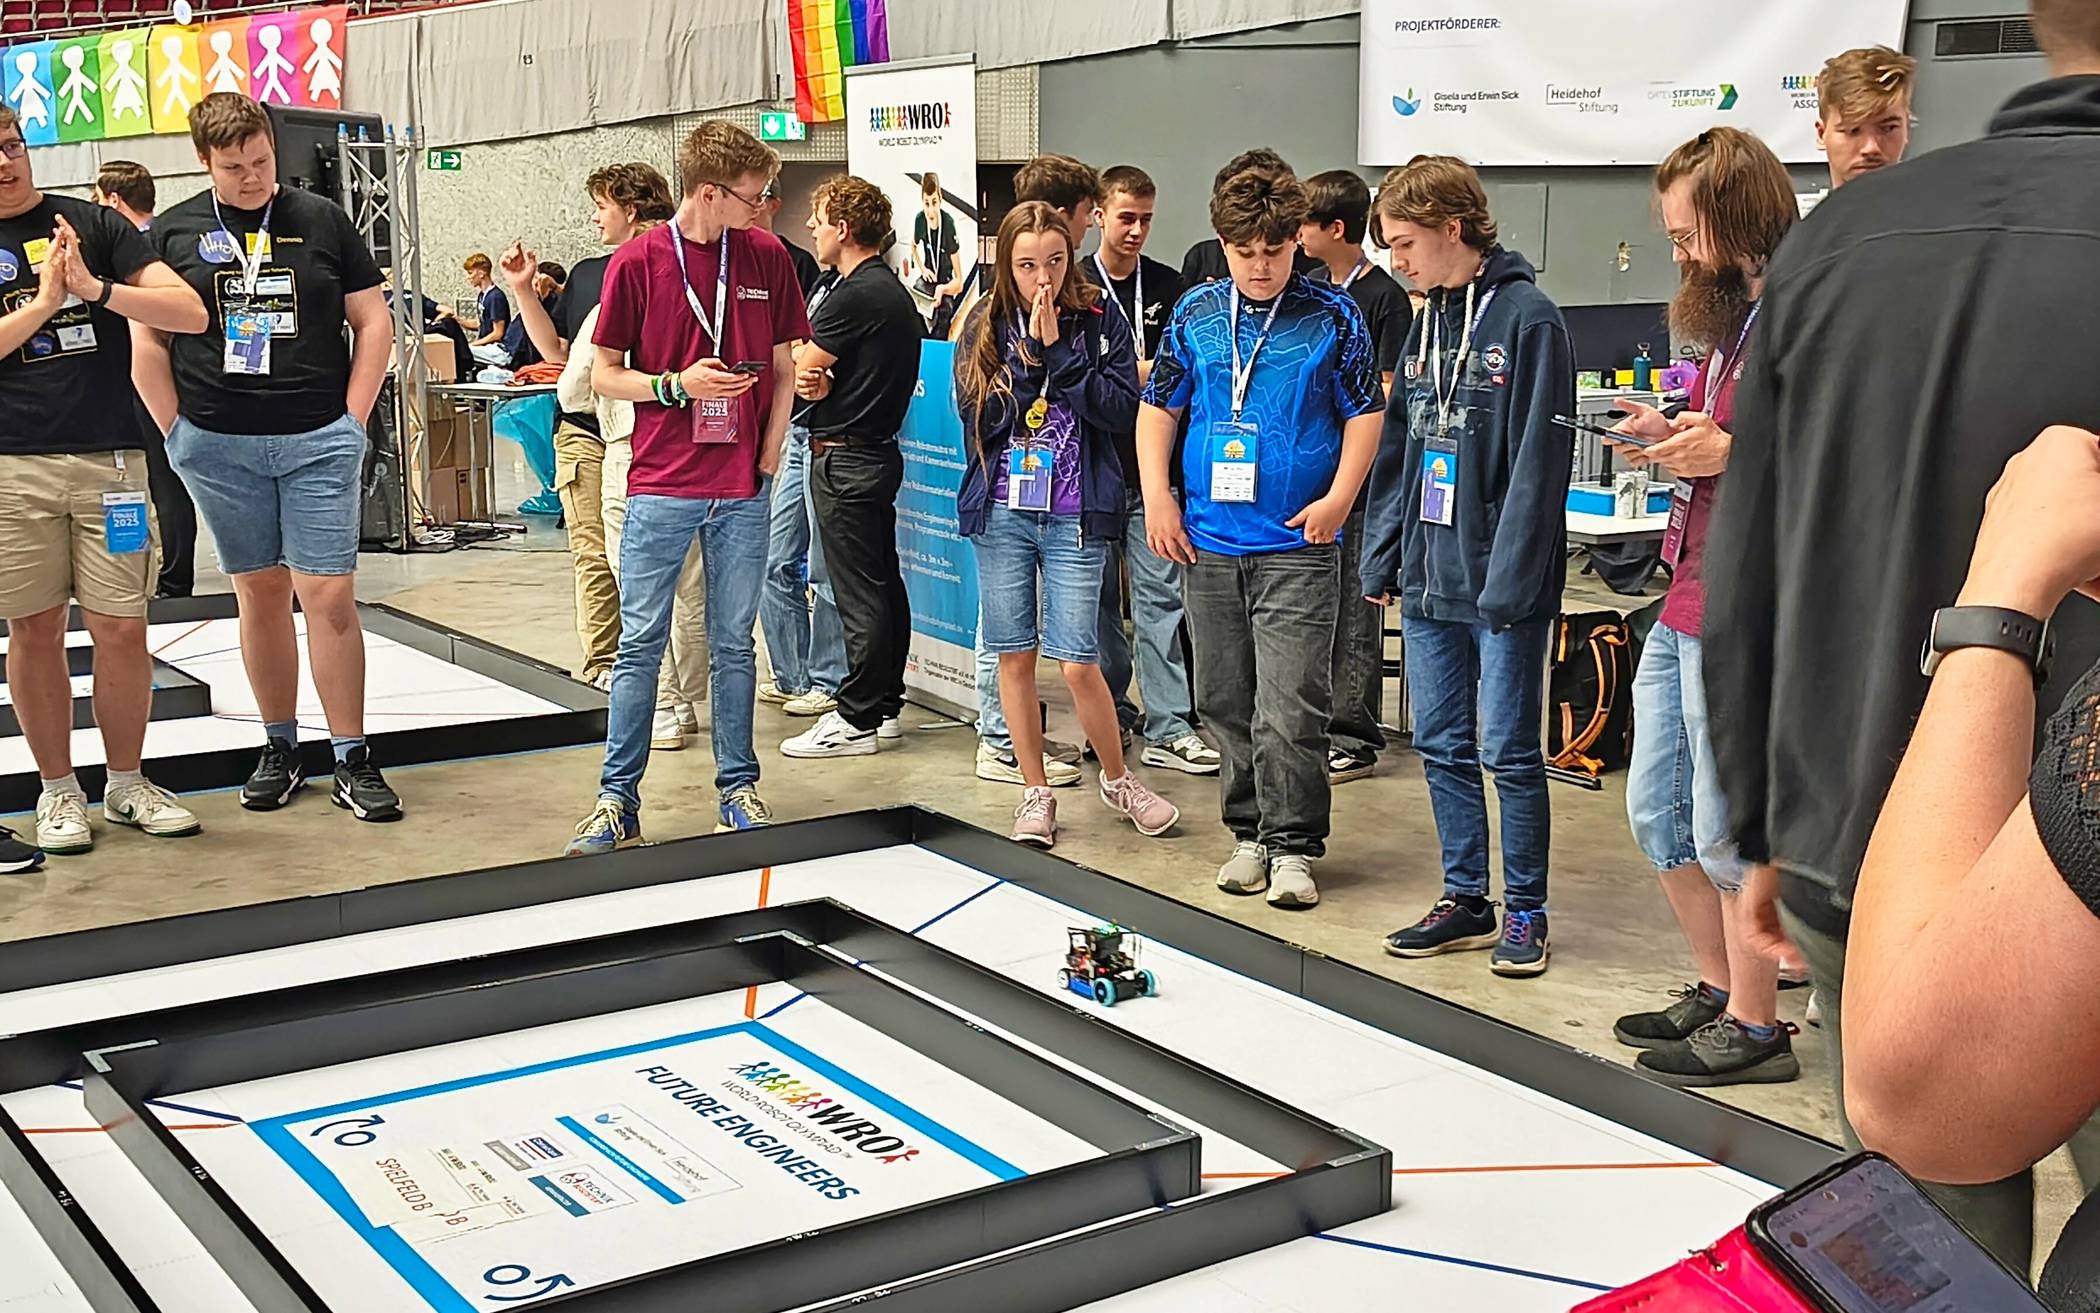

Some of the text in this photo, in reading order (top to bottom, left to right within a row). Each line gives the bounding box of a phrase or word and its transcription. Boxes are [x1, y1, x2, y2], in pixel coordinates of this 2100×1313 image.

[1395, 17, 1502, 33] PROJEKTFÖRDERER:
[1433, 91, 1519, 101] Gisela und Erwin Sick
[1551, 87, 1601, 99] Heidehof
[1672, 89, 1716, 99] STIFTUNG
[1433, 103, 1467, 113] Stiftung
[1579, 101, 1618, 113] Stiftung
[1672, 98, 1714, 107] ZUKUNFT
[1793, 100, 1819, 109] ASSO
[907, 102, 943, 130] WRO
[702, 407, 728, 417] 2025
[113, 518, 140, 528] 2025
[635, 1066, 732, 1118] FUTURE
[711, 1114, 861, 1201] ENGINEERS
[808, 1104, 905, 1155] WRO
[376, 1157, 434, 1212] SPIELFELD B
